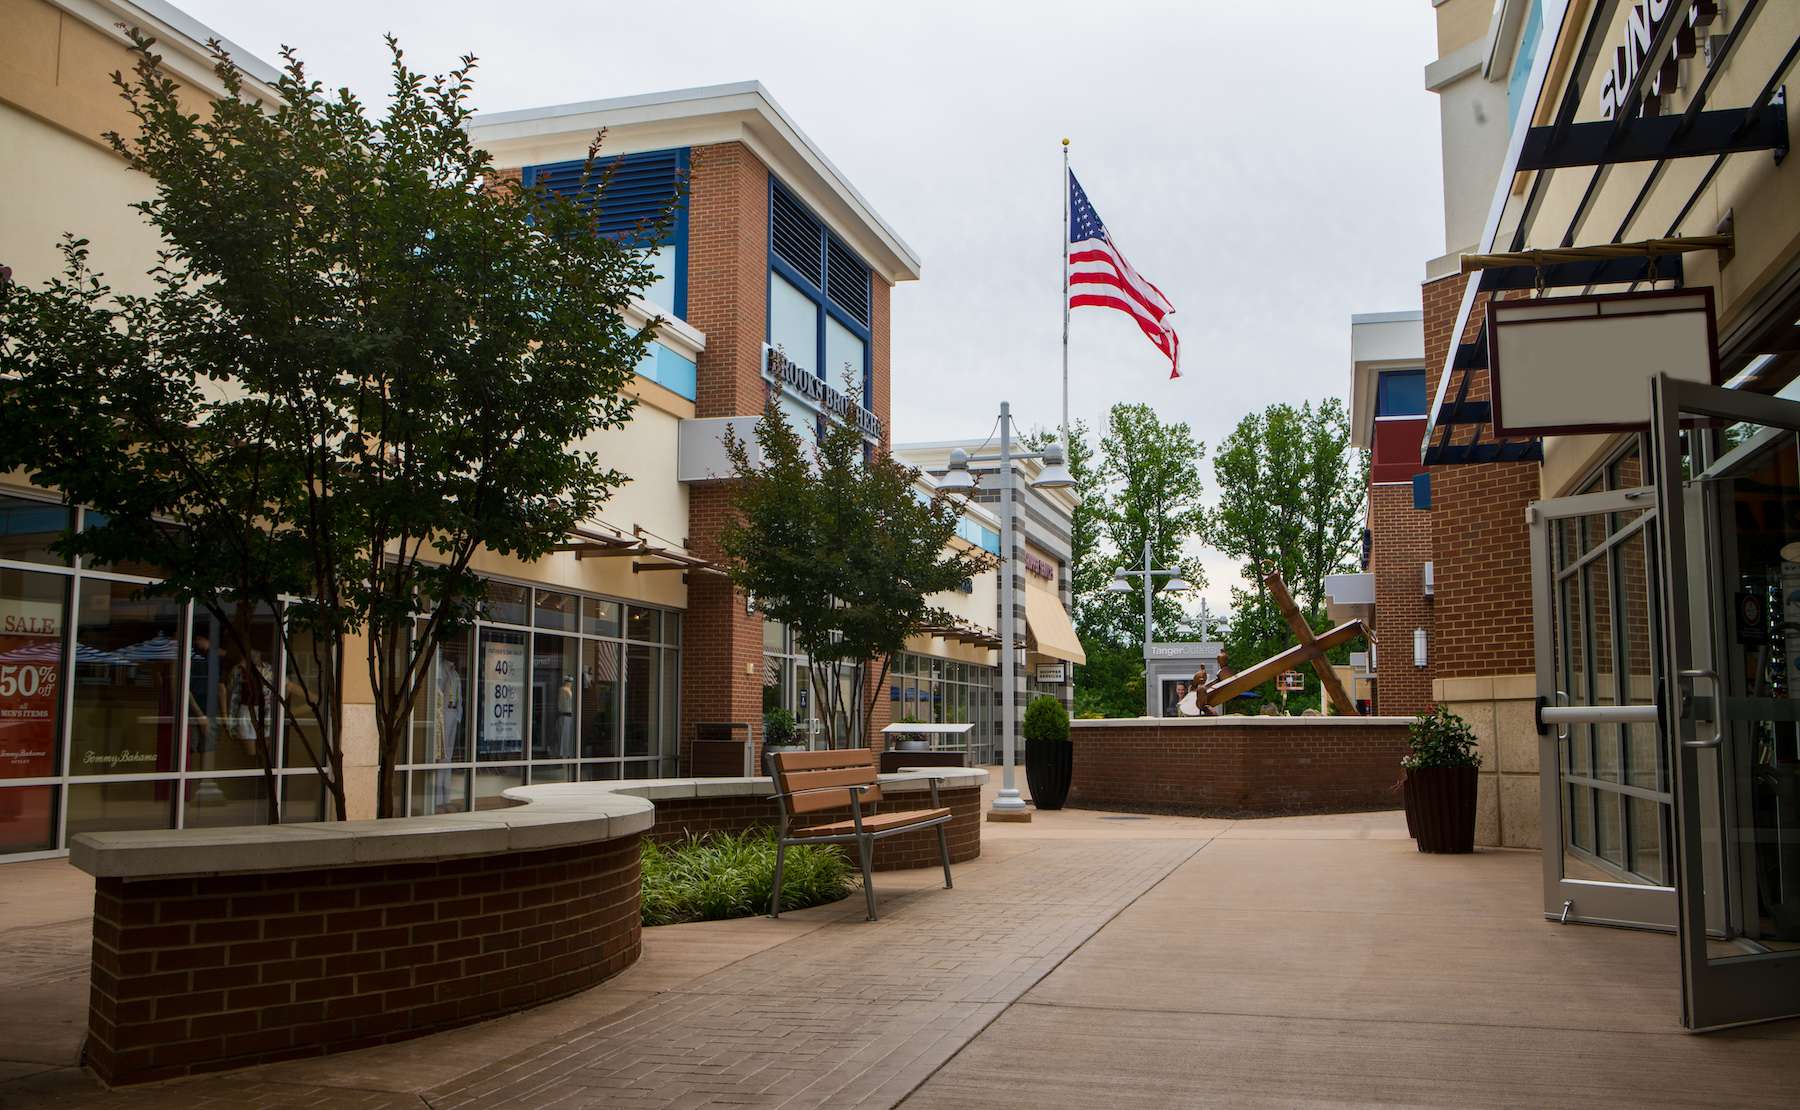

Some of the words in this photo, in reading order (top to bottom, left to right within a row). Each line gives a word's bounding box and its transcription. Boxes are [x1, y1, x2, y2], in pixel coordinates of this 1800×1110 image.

[768, 349, 823, 401] BROOKS
[5, 615, 55, 634] SALE
[38, 684, 55, 697] off
[494, 704, 514, 718] OFF
[83, 751, 118, 768] Tommy
[119, 750, 158, 762] Bahama
